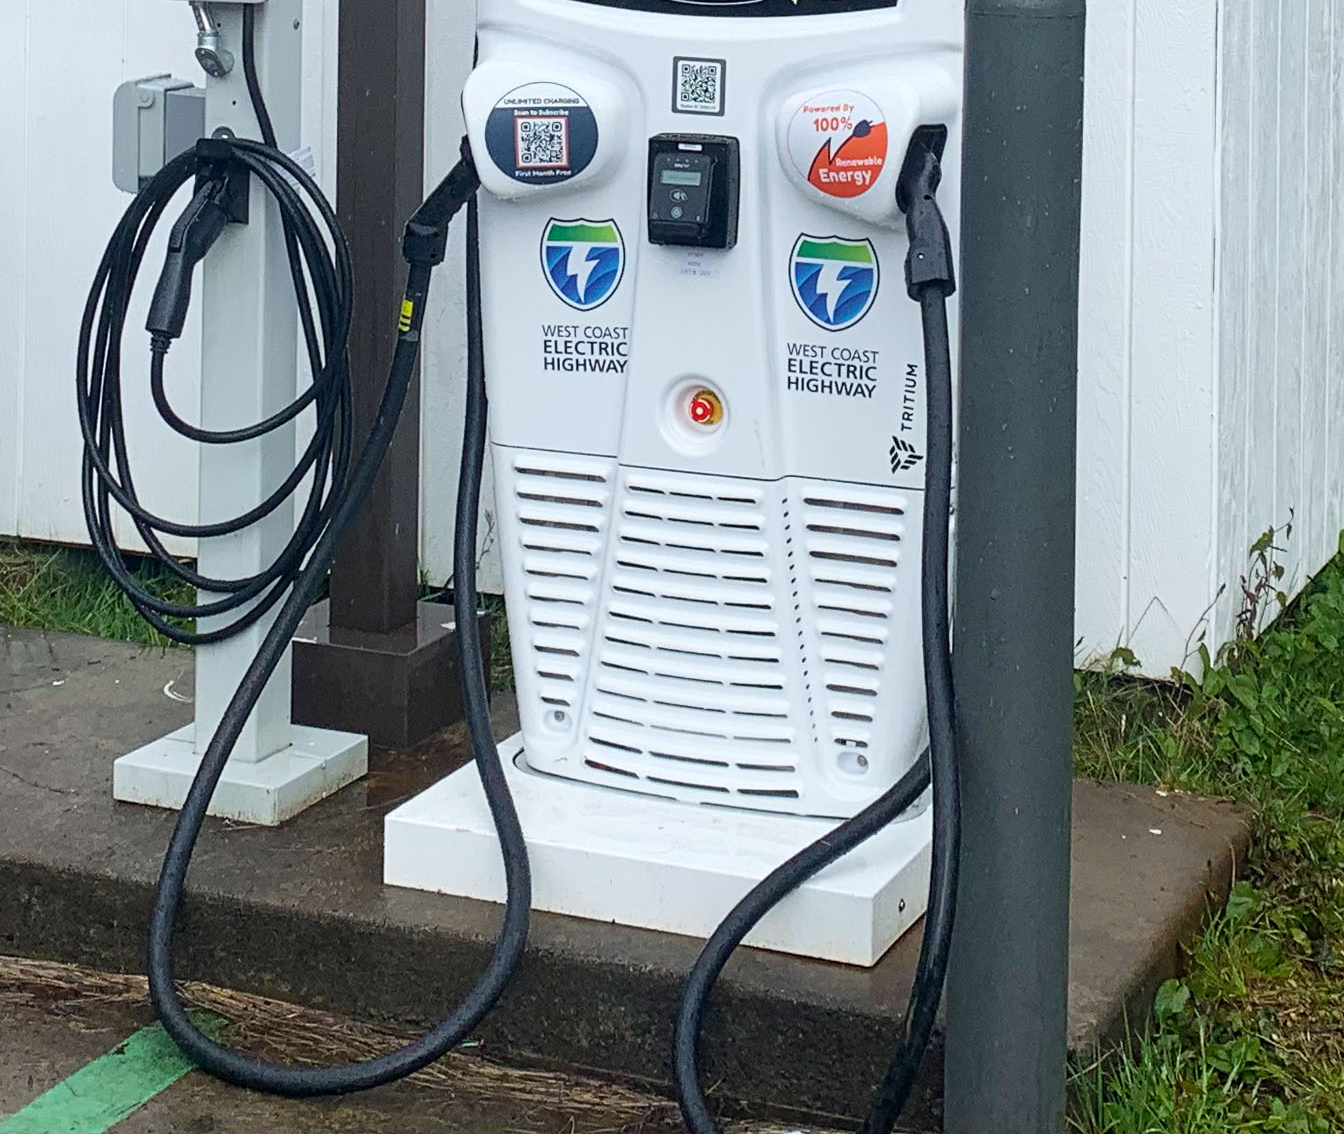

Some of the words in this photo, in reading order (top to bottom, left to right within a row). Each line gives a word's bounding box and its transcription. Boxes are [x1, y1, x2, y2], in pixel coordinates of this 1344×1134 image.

[803, 104, 841, 113] Powered
[842, 103, 855, 113] By
[813, 116, 853, 132] 100%
[835, 156, 883, 167] Renewable
[818, 168, 872, 186] Energy
[542, 325, 580, 338] WEST
[583, 326, 629, 340] COAST
[543, 339, 628, 357] ELECTRIC
[787, 342, 827, 358] WEST
[830, 347, 879, 364] COAST
[543, 357, 628, 373] HIGHWAY
[787, 358, 878, 382] ELECTRIC
[787, 376, 877, 399] HIGHWAY
[900, 363, 918, 432] TRITIUM
